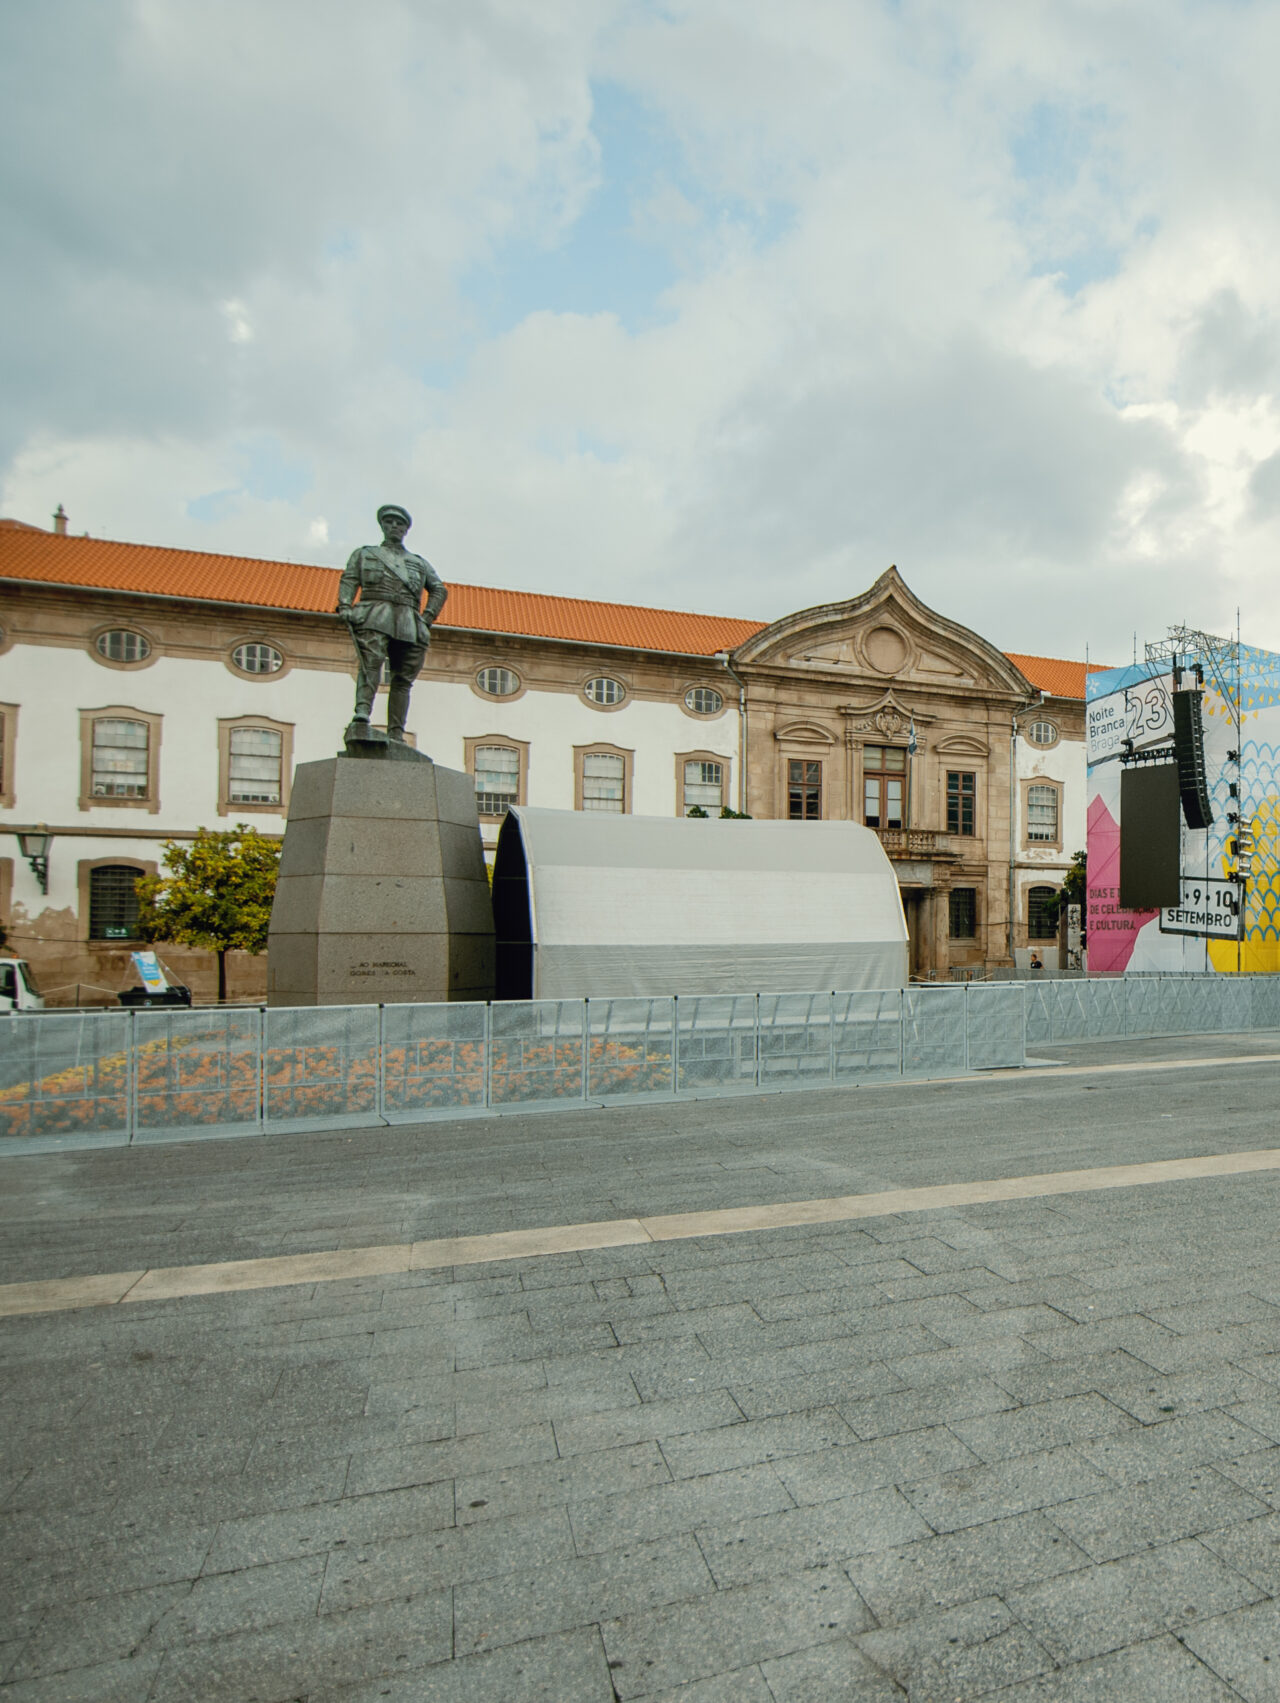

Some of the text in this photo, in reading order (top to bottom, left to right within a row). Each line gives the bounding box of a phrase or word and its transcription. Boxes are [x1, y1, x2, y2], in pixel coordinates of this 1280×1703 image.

[1089, 707, 1114, 724] Noite
[1125, 688, 1168, 740] 23
[1090, 718, 1125, 738] Branca
[1091, 735, 1120, 753] Braga
[1089, 888, 1108, 899] DIAS
[1109, 888, 1115, 898] E
[1193, 889, 1233, 907] 9 10
[1090, 904, 1099, 915] DE
[1167, 909, 1232, 927] SETEMBRO
[1089, 919, 1136, 931] E CULTURA
